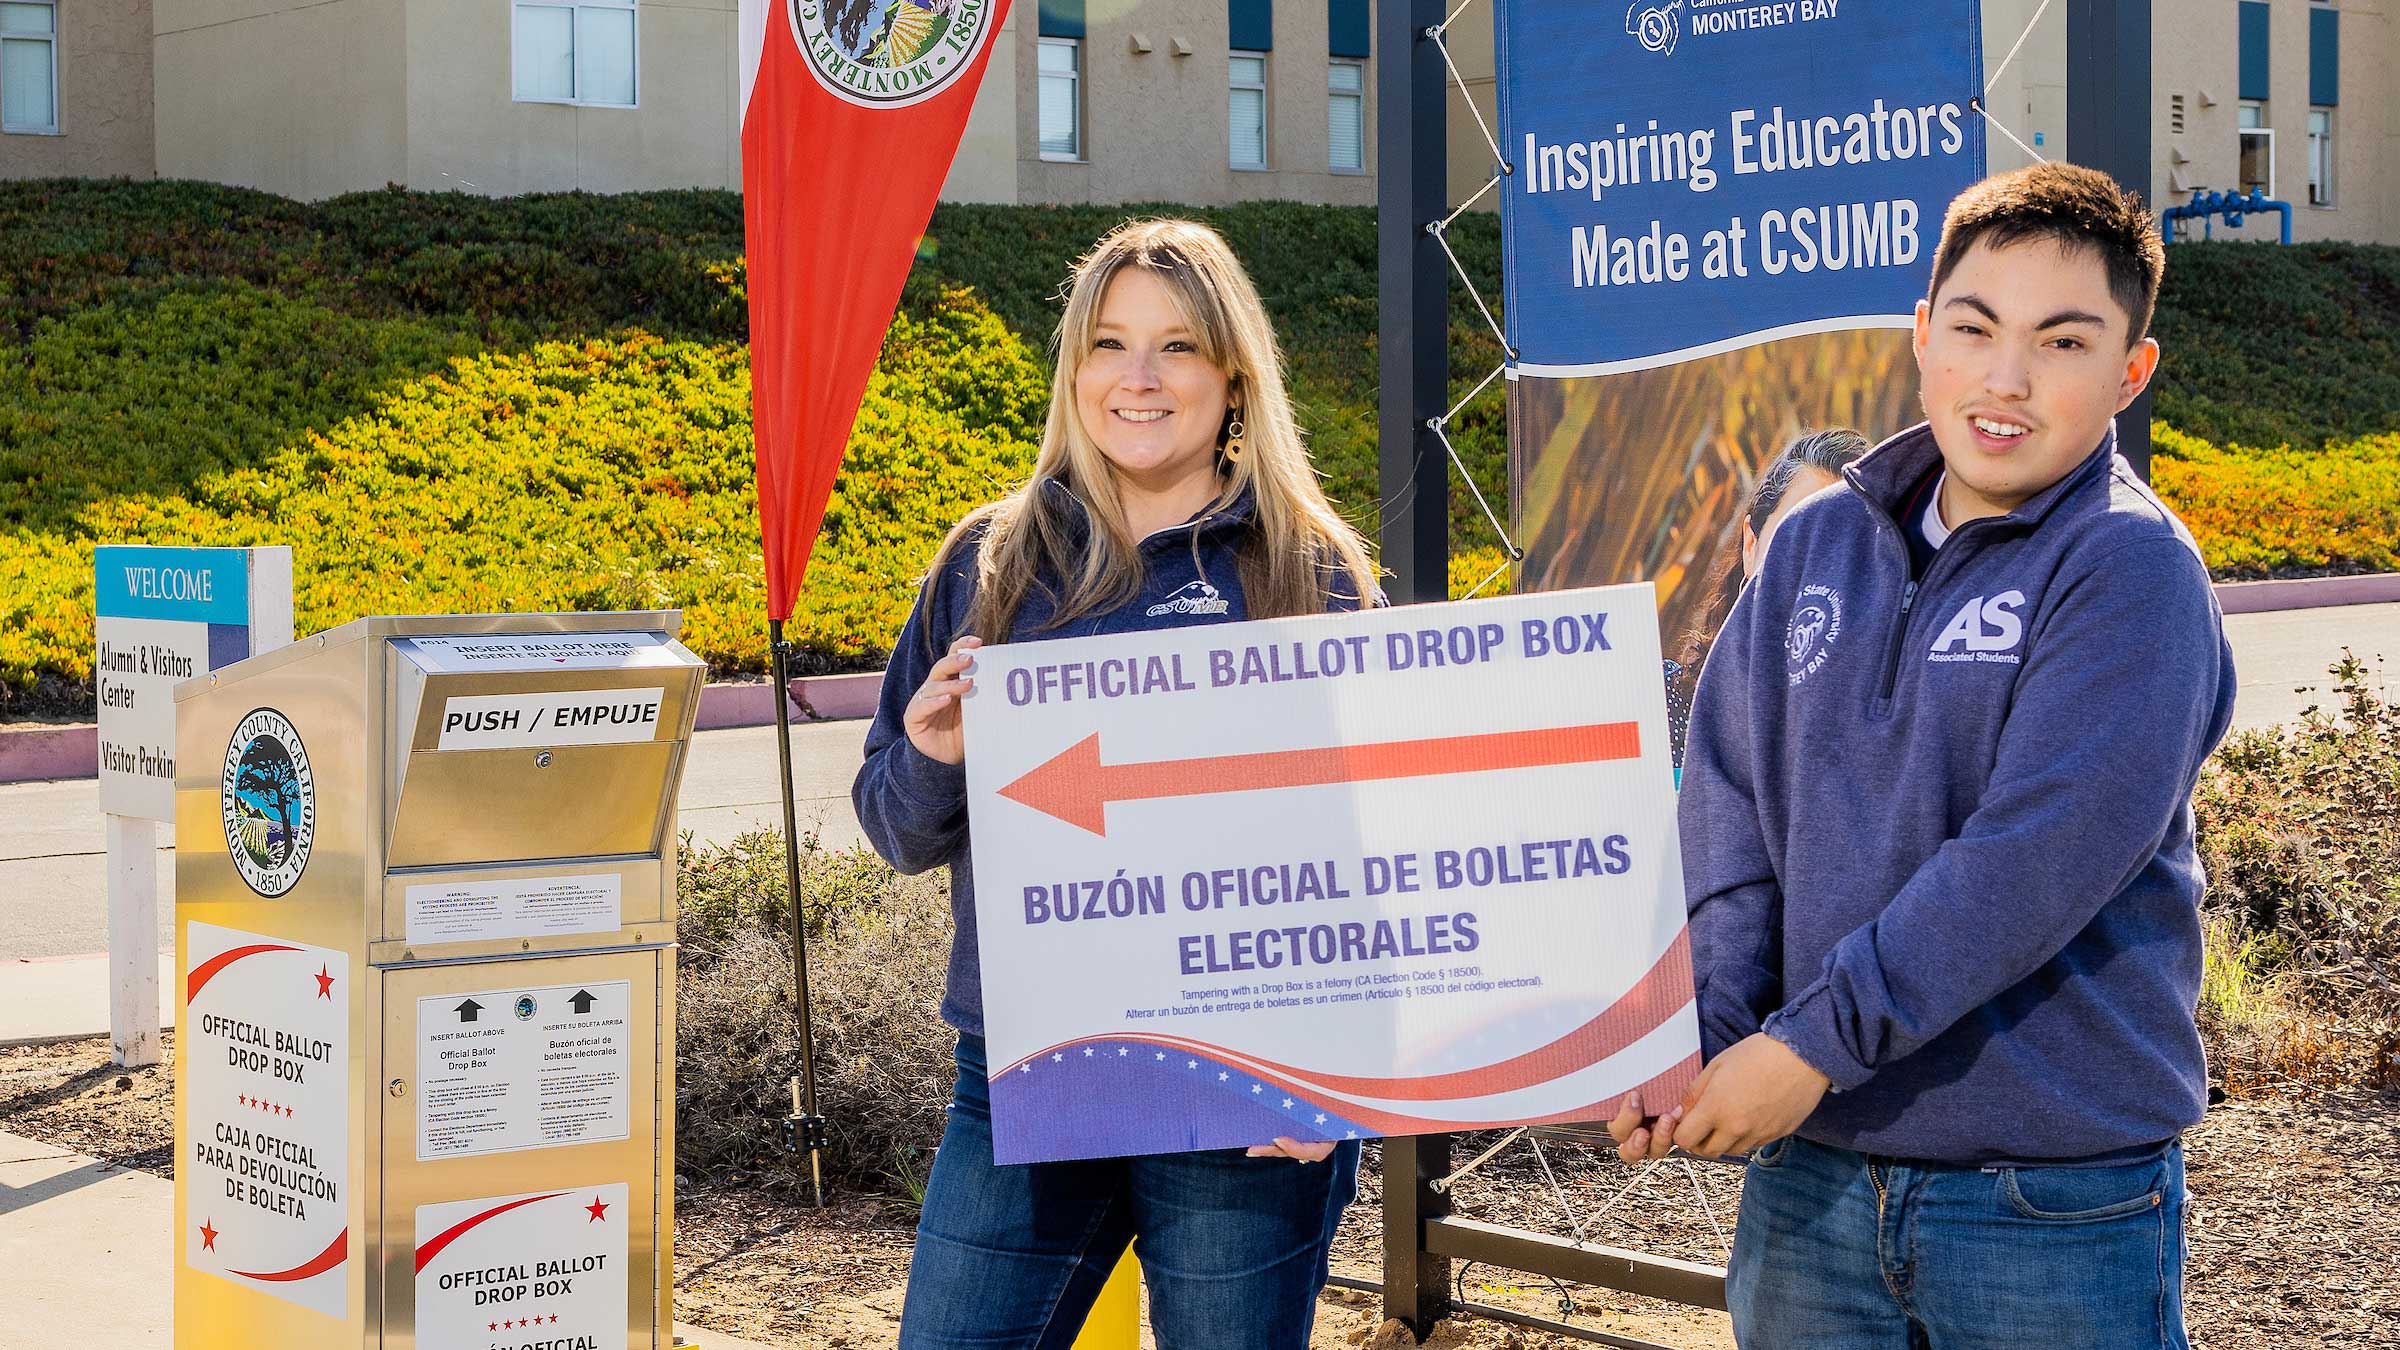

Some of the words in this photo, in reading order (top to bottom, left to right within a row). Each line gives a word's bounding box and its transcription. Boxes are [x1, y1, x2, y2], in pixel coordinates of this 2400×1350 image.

[944, 0, 982, 55] 1850
[1692, 2, 1796, 36] MONTEREY
[1801, 0, 1839, 22] BAY
[809, 31, 935, 93] MONTEREY
[1525, 119, 1718, 201] Inspiring
[1731, 98, 1964, 175] Educators
[1571, 220, 1690, 288] Made
[1702, 216, 1748, 279] at
[1760, 199, 1920, 275] CSUMB
[125, 567, 213, 602] WELCOME
[1146, 597, 1229, 617] CSUMB
[1930, 590, 2026, 652] AS
[101, 641, 136, 673] Alumni
[141, 651, 148, 672] &
[150, 644, 192, 677] Visitors
[453, 645, 517, 653] INSERT
[523, 643, 589, 651] BALLOT
[549, 650, 610, 658] BOLETA
[1005, 653, 1196, 707] OFFICIAL
[1209, 635, 1371, 688] BALLOT
[1385, 622, 1507, 672] DROP
[1521, 612, 1612, 659] BOX
[1807, 648, 1829, 674] BAY
[1927, 651, 1975, 662] Associated
[1976, 652, 2020, 664] Students
[101, 677, 135, 709] Center
[446, 709, 521, 733] PUSH
[528, 708, 544, 733] /
[554, 703, 658, 727] EMPUJE
[102, 741, 136, 774] Visitor
[139, 745, 176, 787] Parkin
[224, 740, 247, 870] MONTEREY
[242, 715, 289, 741] COUNTY
[289, 739, 314, 874] CALIFORNIA
[255, 871, 283, 893] 1850
[1023, 869, 1166, 925] BUZÓN
[1180, 859, 1350, 912] OFICIAL
[1362, 852, 1419, 896] DE
[1434, 833, 1632, 891] BOLETAS
[1178, 911, 1481, 976] ELECTORALES
[1125, 1007, 1155, 1019] Alterar
[1158, 1008, 1170, 1017] un
[1172, 1004, 1200, 1016] buzón
[1202, 1003, 1214, 1013] de
[1216, 1000, 1251, 1013] entrega
[1253, 998, 1265, 1009] de
[1267, 997, 1301, 1008] boletas
[1303, 997, 1314, 1005] es
[1316, 995, 1329, 1004] un
[1330, 991, 1362, 1003] crimen
[1405, 987, 1412, 998] §
[1415, 985, 1445, 995] 18500
[1447, 982, 1461, 993] del
[1181, 989, 1229, 1001] Tampering
[1231, 985, 1251, 995] with
[1253, 986, 1259, 994] a
[1262, 983, 1284, 994] Drop
[1286, 981, 1303, 992] Box
[1306, 980, 1314, 990] is
[1325, 977, 1352, 989] felony
[1355, 975, 1371, 988] (CA
[1374, 972, 1410, 984] Election
[1412, 970, 1436, 981] Code
[1438, 969, 1445, 980] §
[202, 1013, 270, 1049] OFFICIAL
[275, 1031, 332, 1064] BALLOT
[430, 1033, 454, 1042] INSERT
[455, 1031, 481, 1040] BALLOT
[482, 1029, 505, 1037] ABOVE
[542, 1023, 567, 1031] INSERTE
[577, 1020, 601, 1029] BOLETA
[601, 1018, 624, 1026] ARRIBA
[549, 1039, 575, 1049] Buzón
[576, 1037, 601, 1047] oficial
[602, 1036, 612, 1044] de
[228, 1046, 268, 1073] DROP
[274, 1058, 304, 1084] BOX
[440, 1049, 470, 1060] Official
[472, 1047, 496, 1057] Ballot
[448, 1061, 469, 1071] Drop
[471, 1060, 487, 1068] Box
[544, 1051, 573, 1061] boletas
[574, 1047, 617, 1059] electorales
[215, 1122, 251, 1150] CAJA
[255, 1133, 317, 1169] OFICIAL
[197, 1142, 234, 1172] PARA
[239, 1155, 337, 1203] DEVOLUCIÓN
[226, 1177, 244, 1201] DE
[249, 1184, 306, 1221] BOLETA
[438, 1264, 530, 1290] OFFICIAL
[535, 1254, 607, 1278] BALLOT
[474, 1285, 527, 1306] DROP
[534, 1278, 573, 1298] BOX
